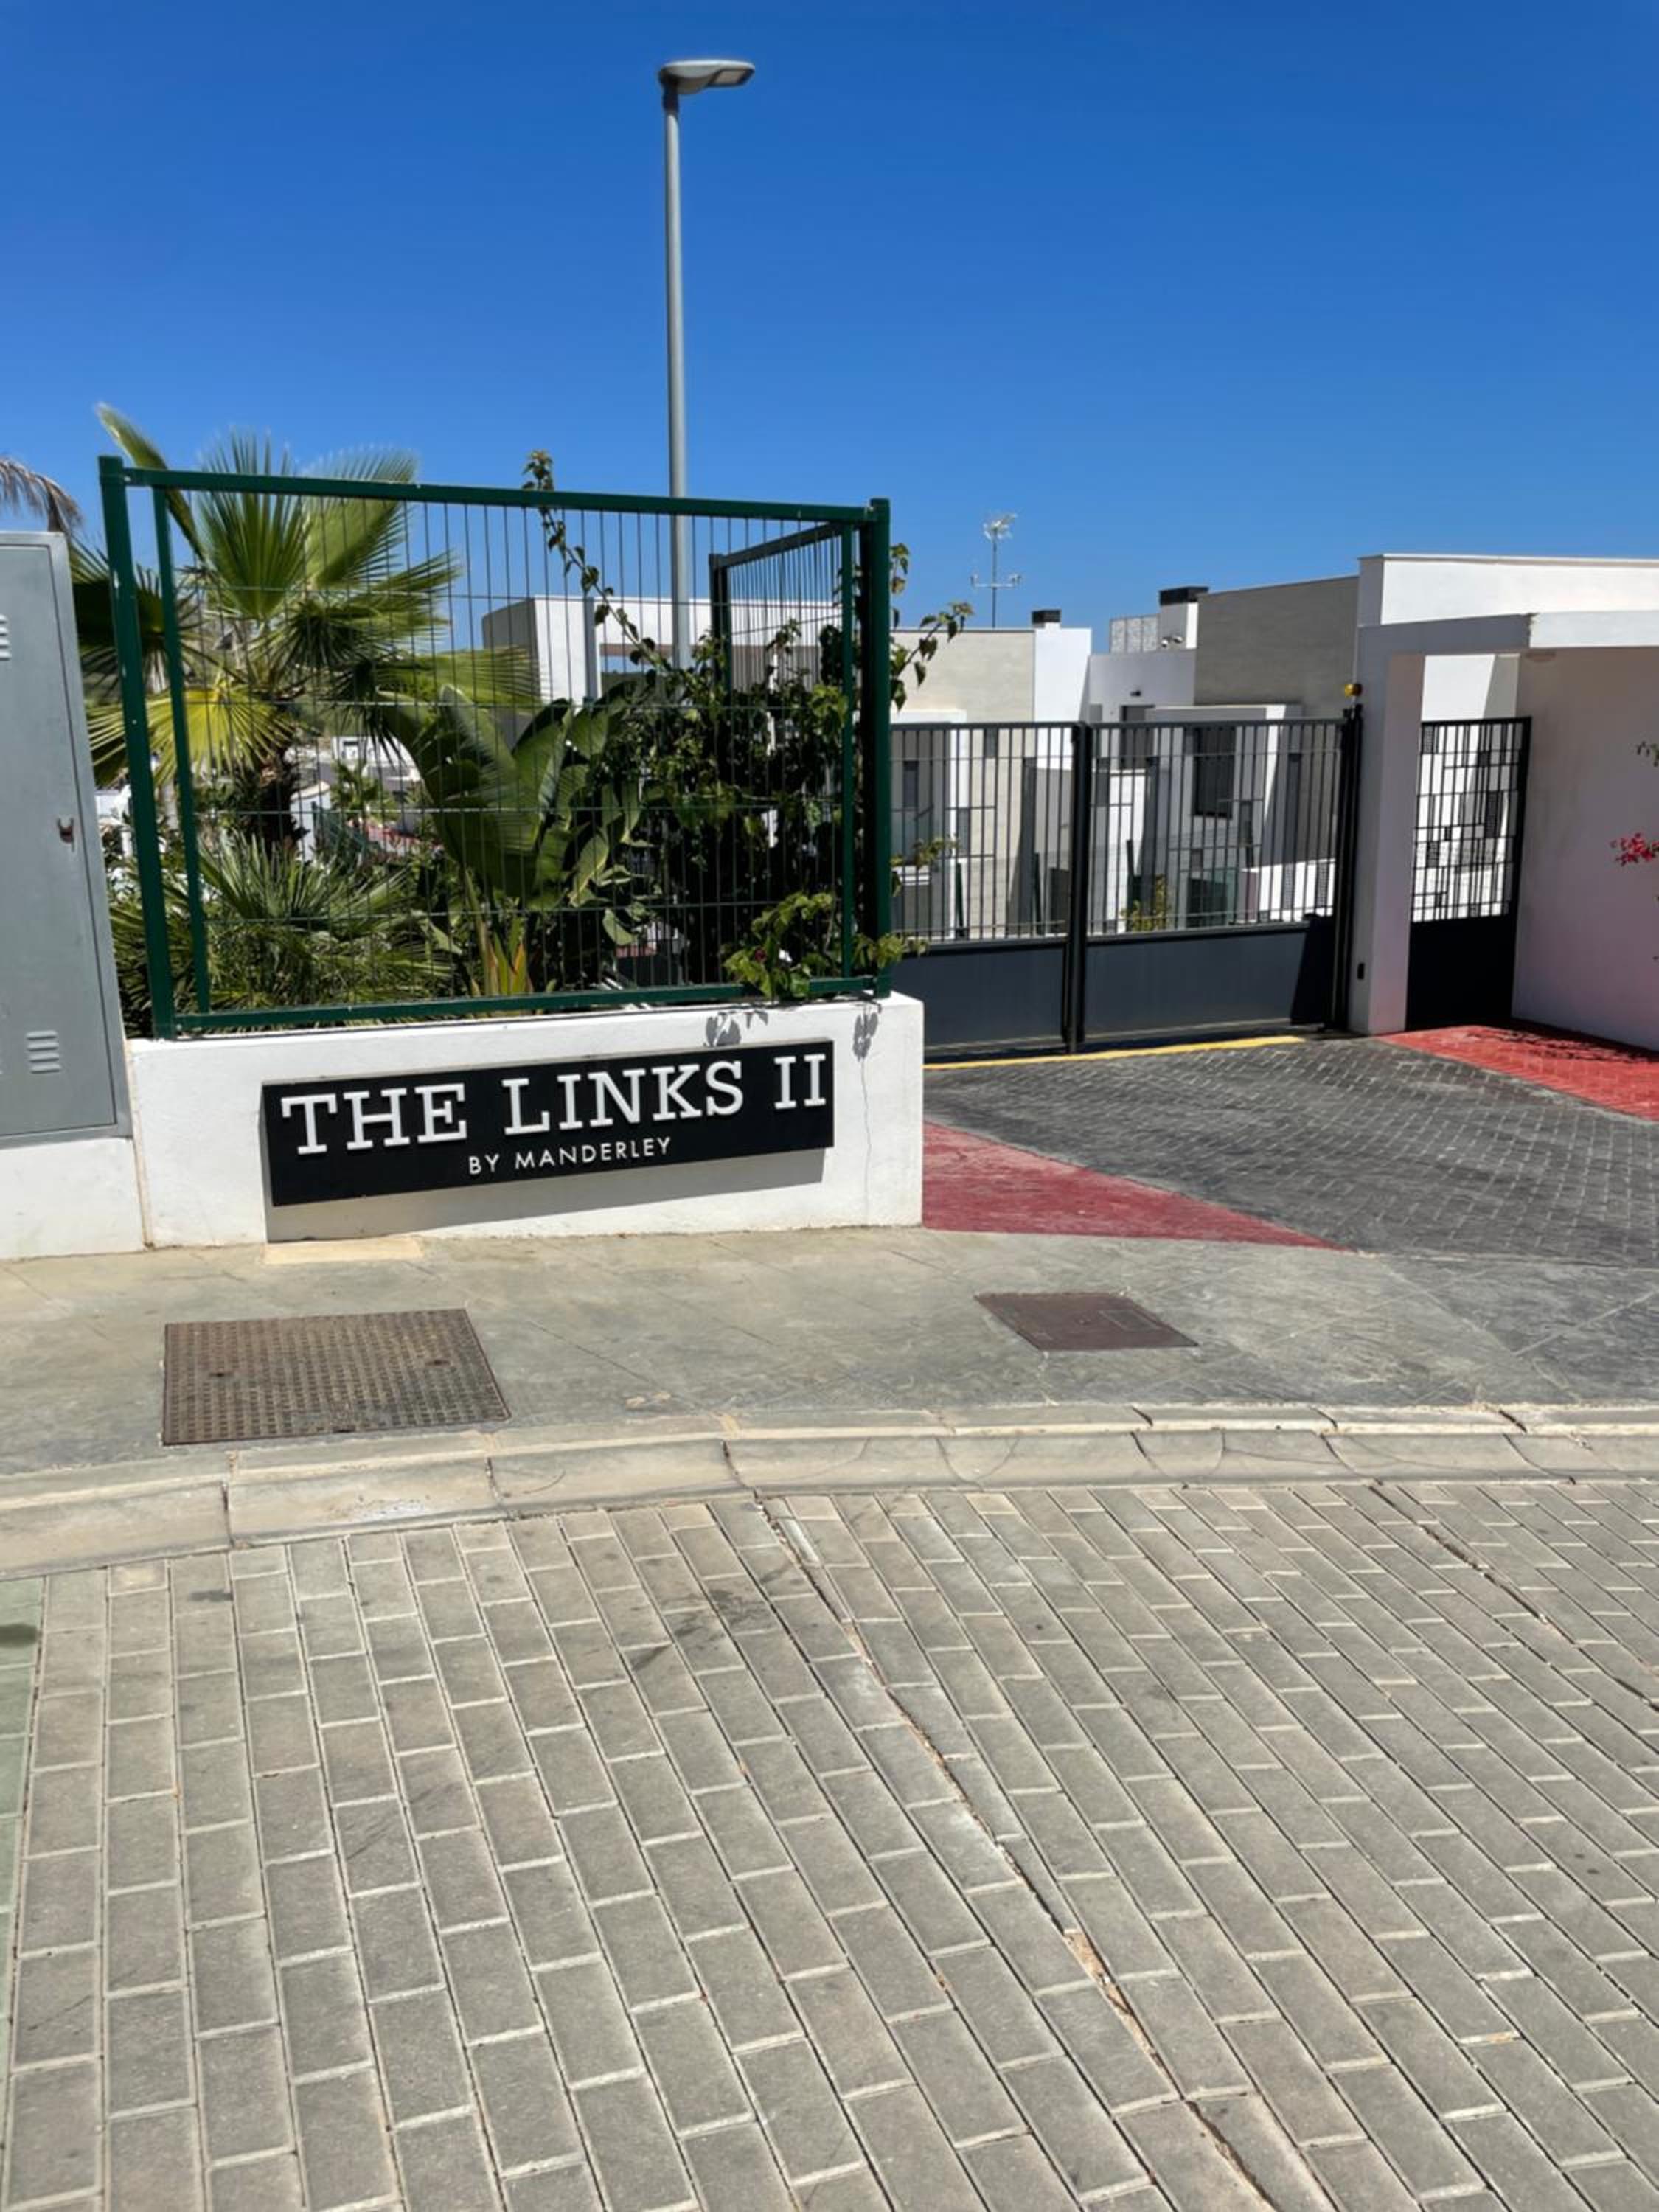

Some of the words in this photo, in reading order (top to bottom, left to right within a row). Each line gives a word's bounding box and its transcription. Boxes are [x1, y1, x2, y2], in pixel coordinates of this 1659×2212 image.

[280, 1082, 467, 1155] THE
[501, 1060, 743, 1135] LINKS
[773, 1053, 827, 1110] II
[469, 1154, 499, 1175] BY
[515, 1137, 671, 1169] MANDERLEY
